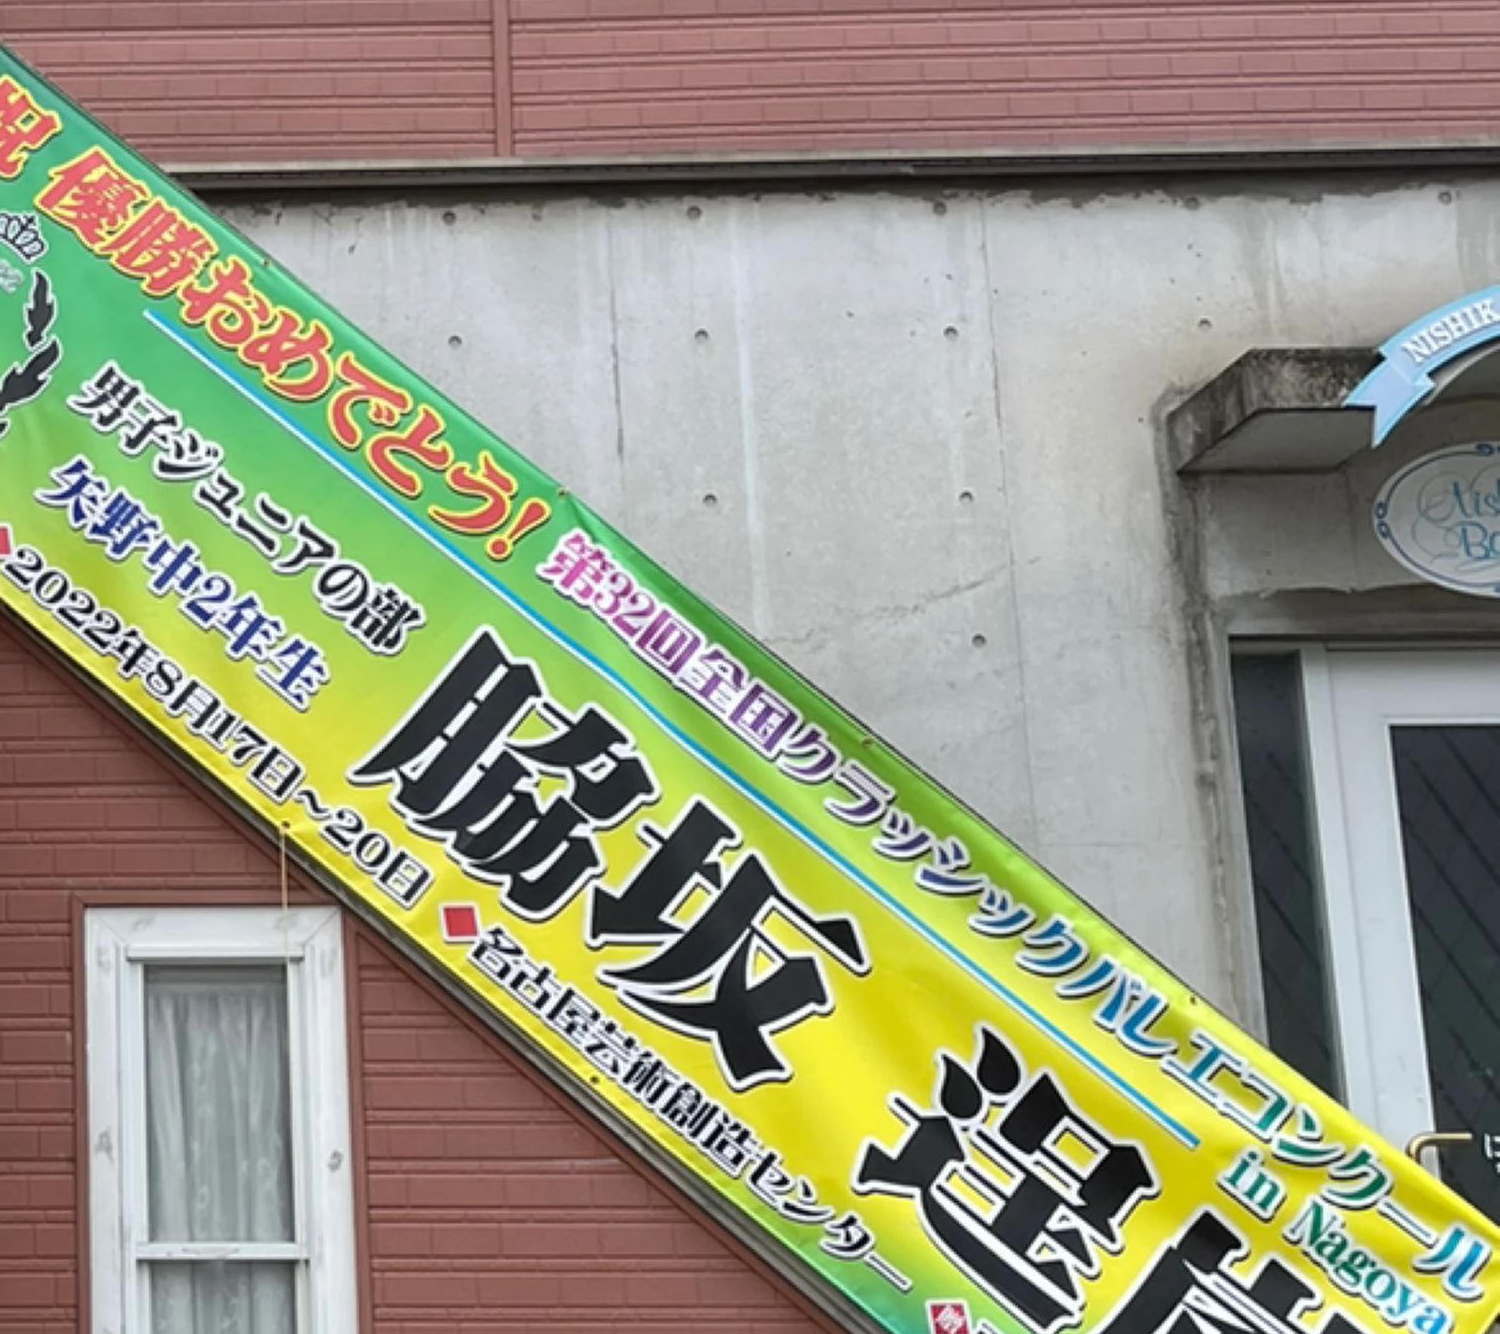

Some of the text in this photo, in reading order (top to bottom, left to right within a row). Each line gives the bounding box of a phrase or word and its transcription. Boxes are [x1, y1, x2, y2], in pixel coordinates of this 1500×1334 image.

[34, 457, 330, 711] 矢野中2年生
[67, 361, 427, 657] 男子ジュニアの部
[346, 625, 870, 1088] 脇坂
[535, 531, 1490, 1299] 第32回全国クラッシックバレエコンクール
[466, 926, 912, 1291] 名古屋芸術創造センター
[1219, 1151, 1285, 1220] in
